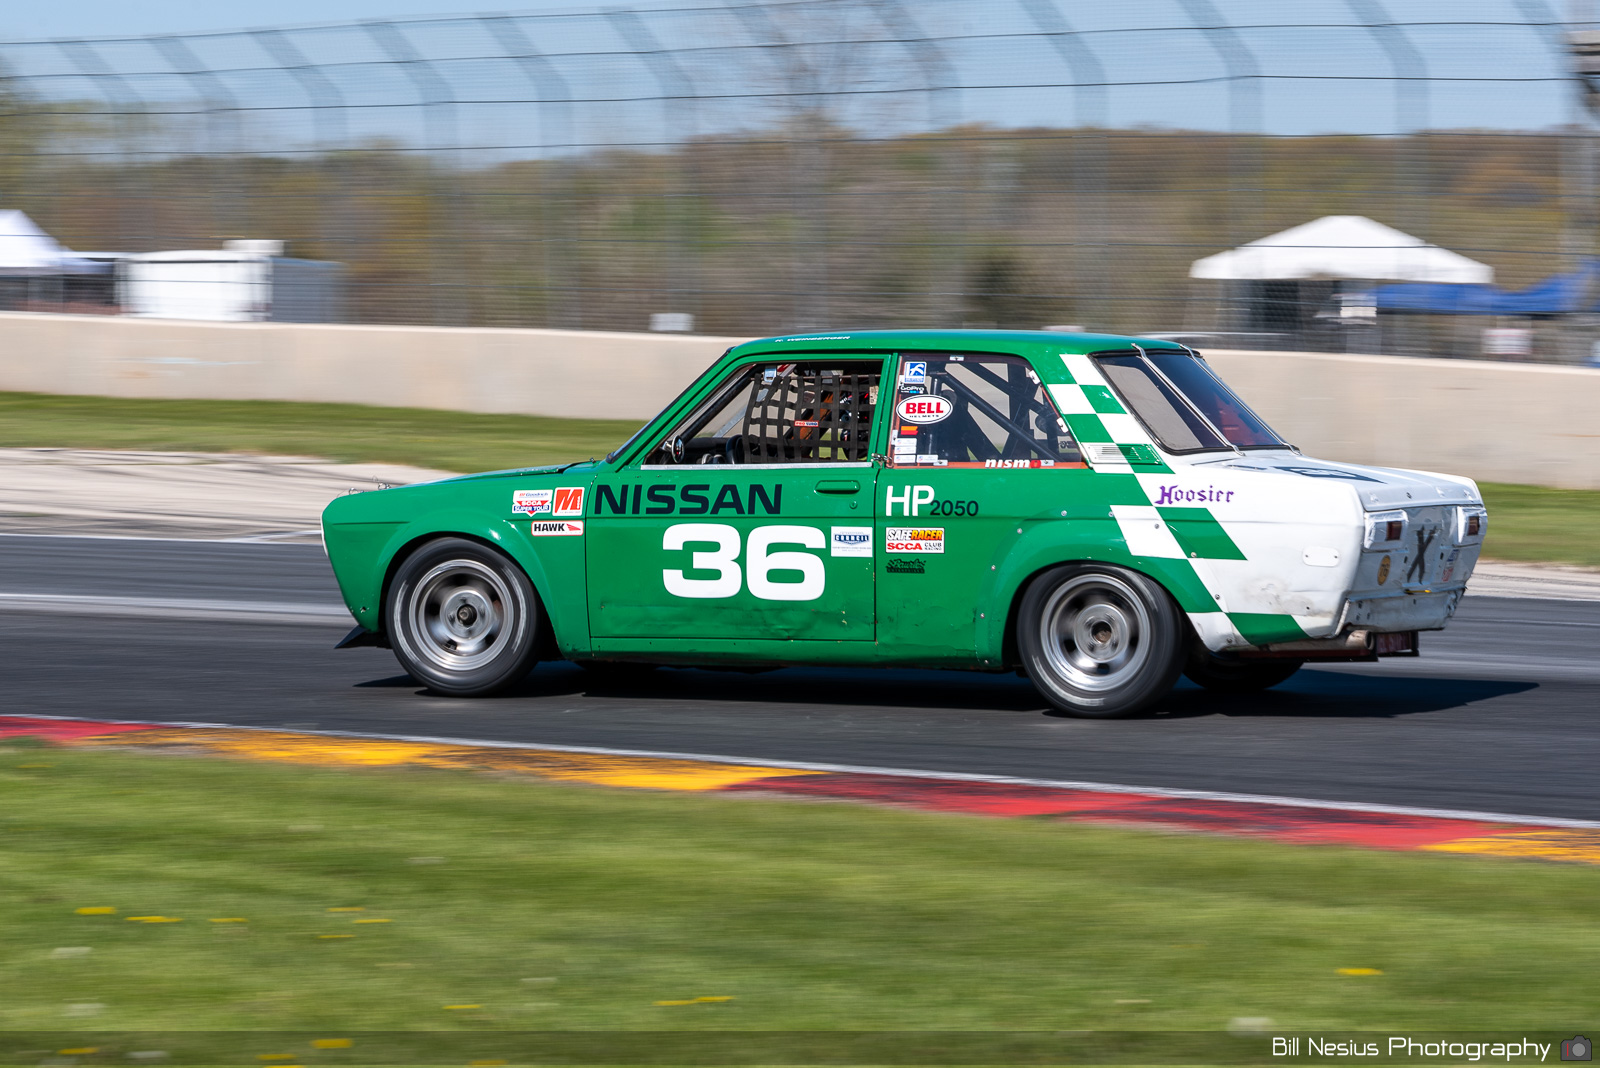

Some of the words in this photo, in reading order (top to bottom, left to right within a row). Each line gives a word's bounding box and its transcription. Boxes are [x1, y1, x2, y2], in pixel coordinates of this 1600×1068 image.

[905, 402, 944, 414] BELL
[594, 484, 782, 514] NISSAN
[886, 485, 935, 516] HP
[930, 500, 979, 516] 2050
[1154, 485, 1235, 504] Hoosier
[534, 523, 566, 532] HAWK
[886, 542, 922, 550] SCCA
[662, 523, 826, 600] 36
